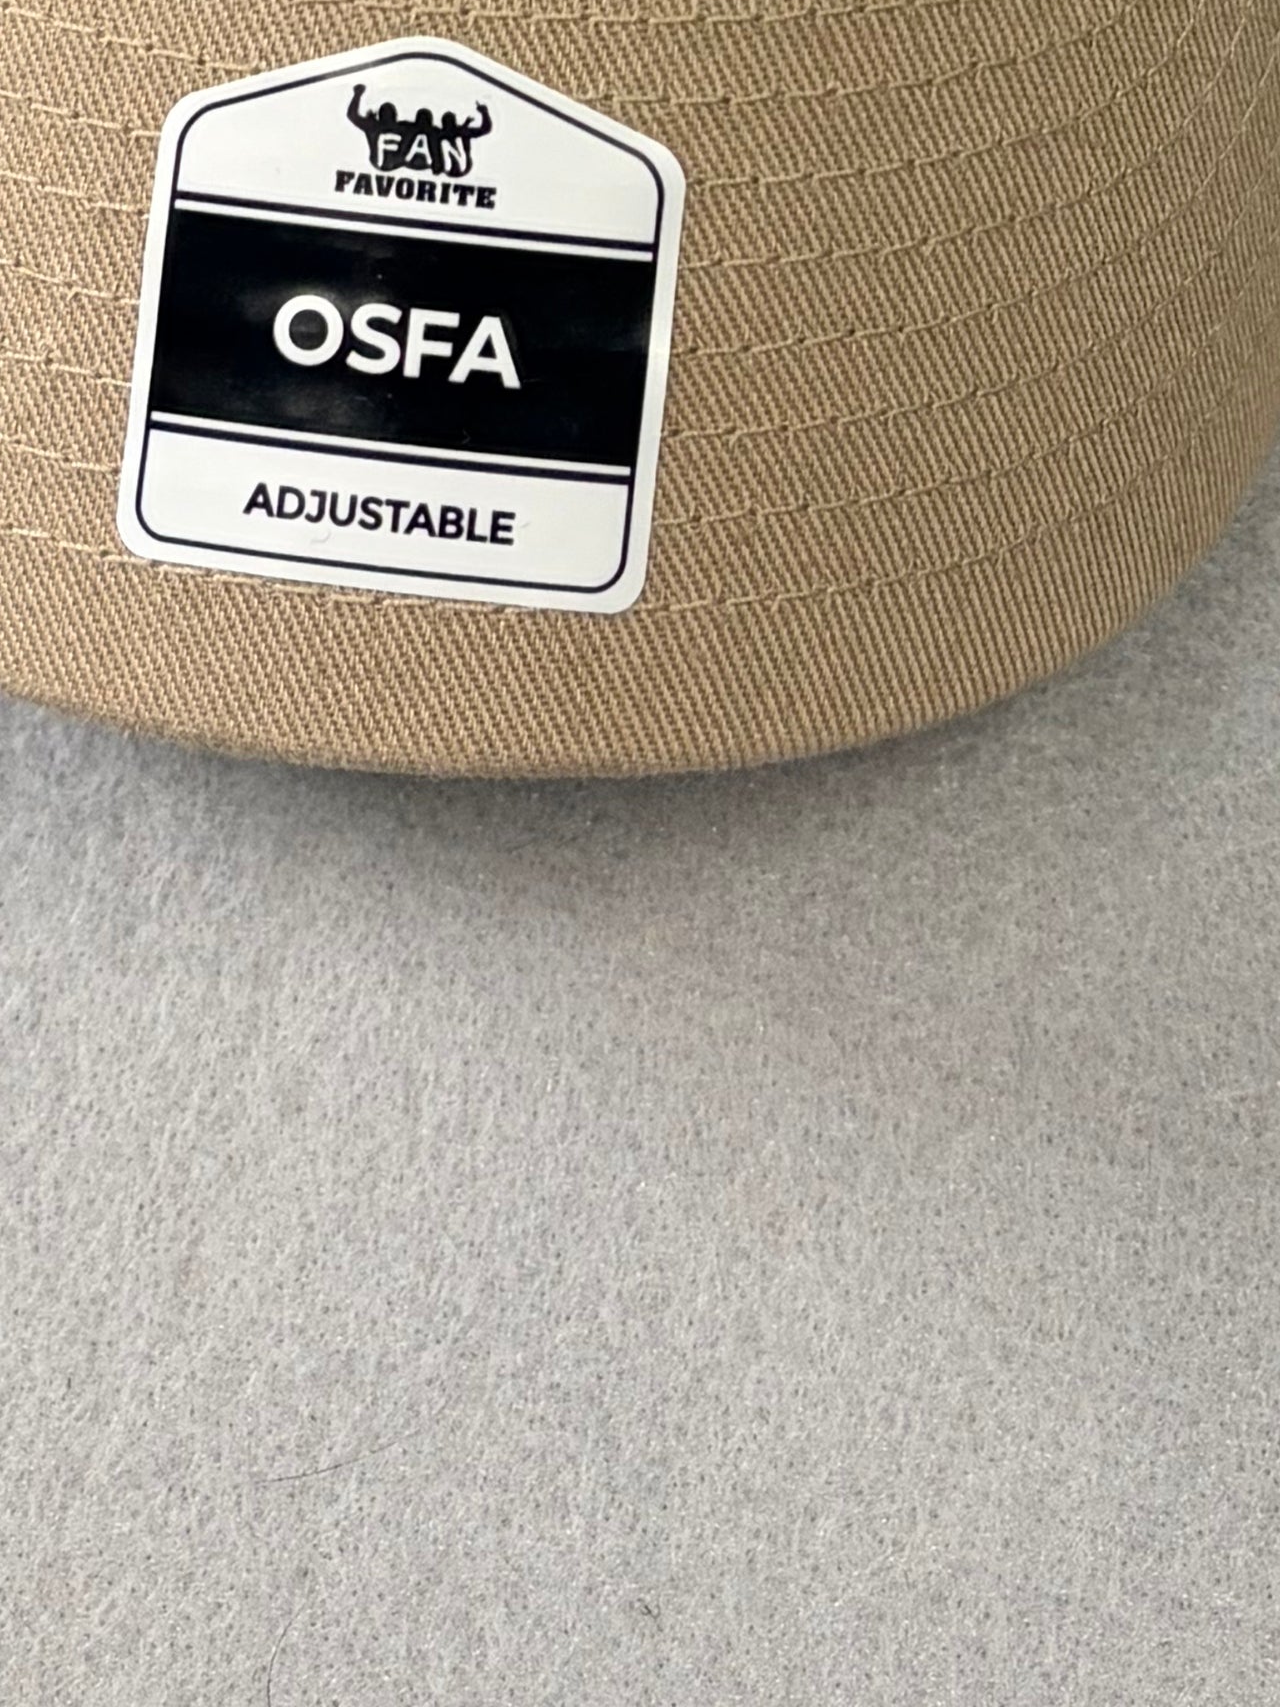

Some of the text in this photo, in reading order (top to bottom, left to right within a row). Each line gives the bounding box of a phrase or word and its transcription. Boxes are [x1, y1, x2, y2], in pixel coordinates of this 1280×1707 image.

[376, 133, 469, 175] FAN
[334, 169, 497, 209] FAVORITE
[273, 295, 520, 389] OSFA
[243, 483, 516, 546] ADJUSTABLE
